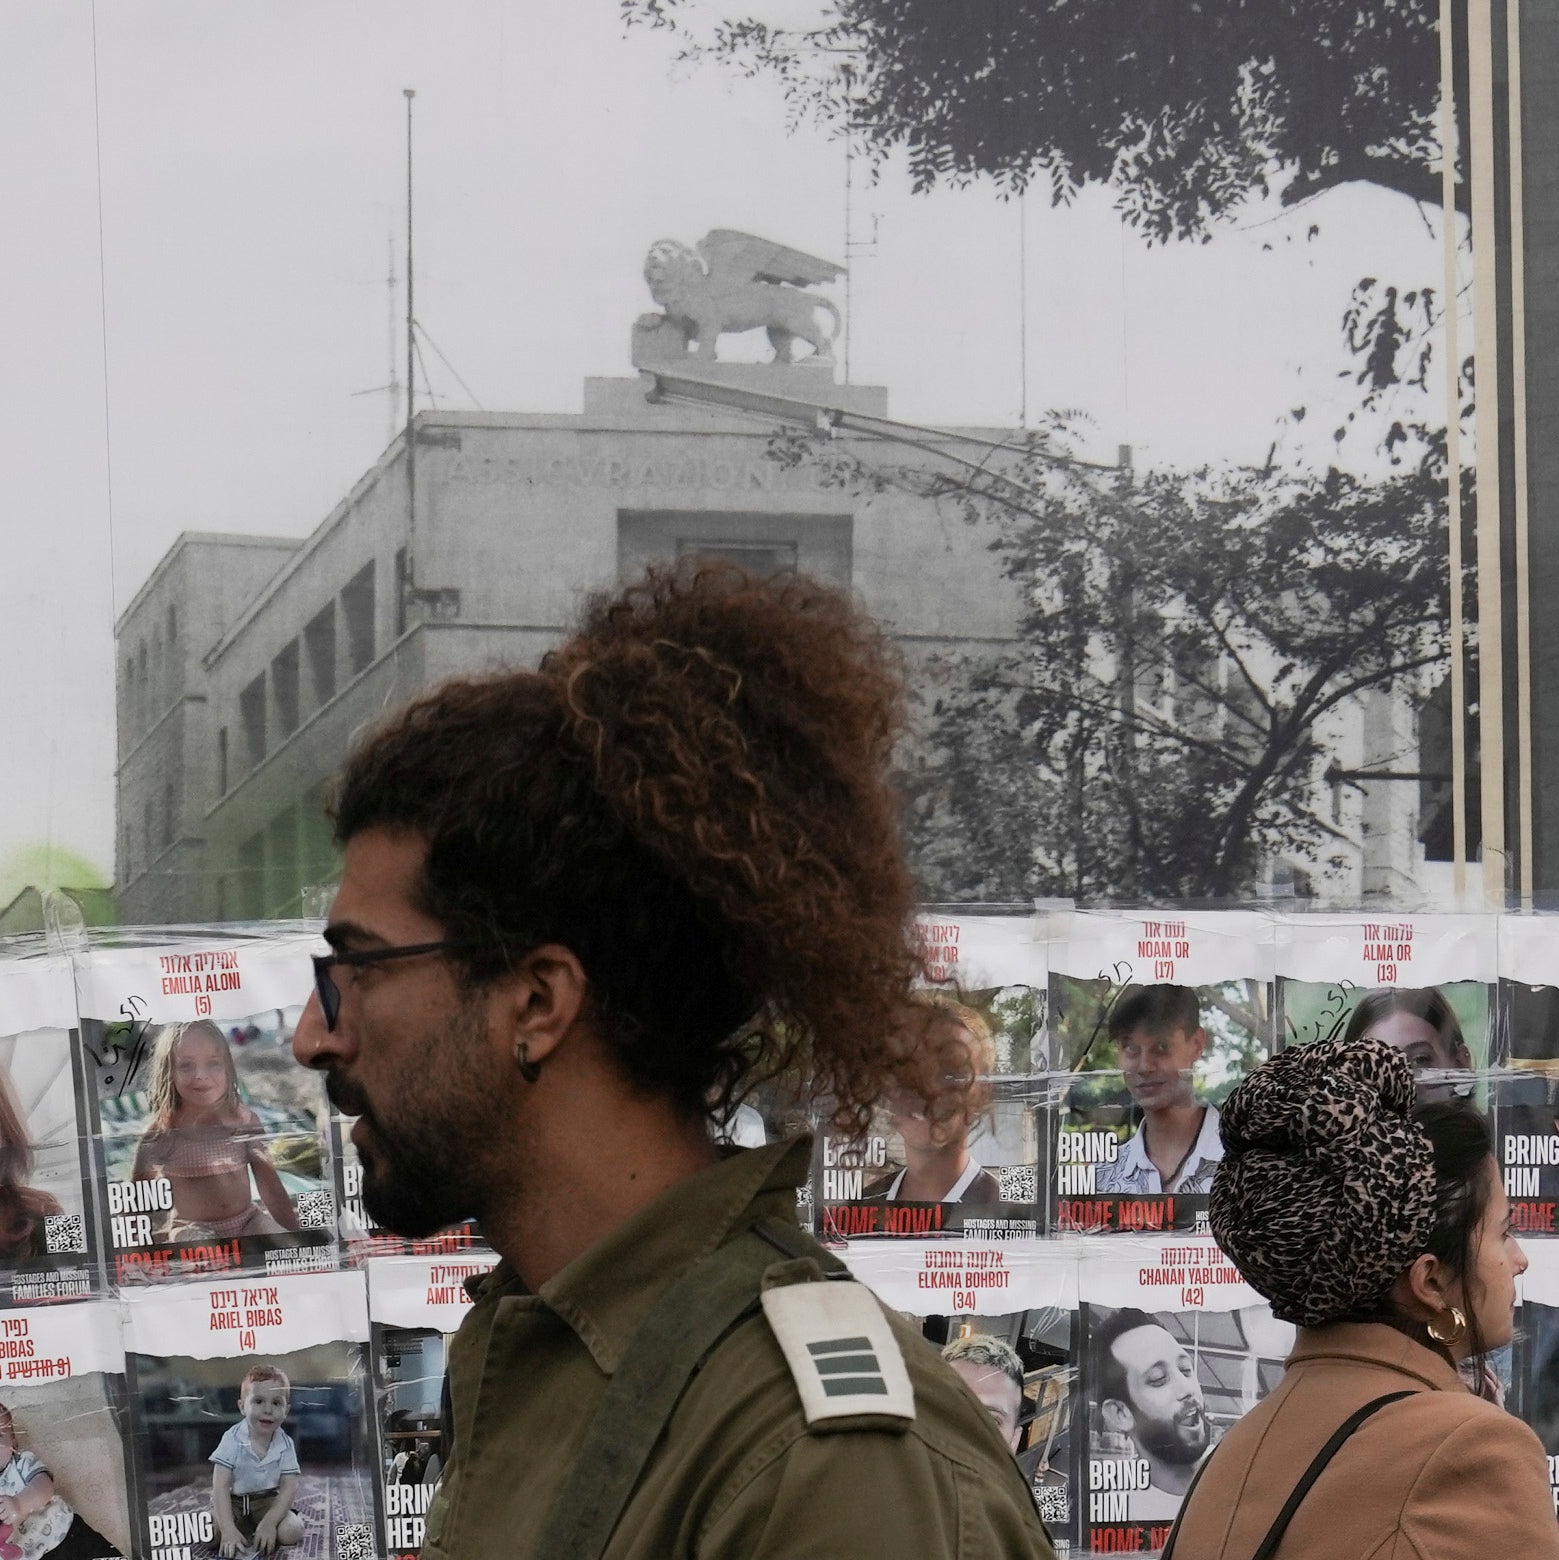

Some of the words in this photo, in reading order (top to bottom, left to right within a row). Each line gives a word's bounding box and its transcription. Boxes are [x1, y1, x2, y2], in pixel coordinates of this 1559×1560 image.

[1138, 940, 1172, 958] NOAM
[1175, 941, 1190, 958] OR
[1363, 944, 1395, 961] ALMA
[1396, 941, 1413, 961] OR
[162, 975, 203, 995] EMILIA
[205, 971, 241, 992] ALONI
[1504, 1167, 1540, 1197] HIM
[918, 1271, 963, 1289] ELKANA
[965, 1270, 1010, 1289] BOHBOT
[1139, 1267, 1186, 1286] CHANAN
[1189, 1265, 1245, 1285] YABLONKA
[210, 1311, 244, 1330] ARIEL
[246, 1307, 283, 1328] BIBAS
